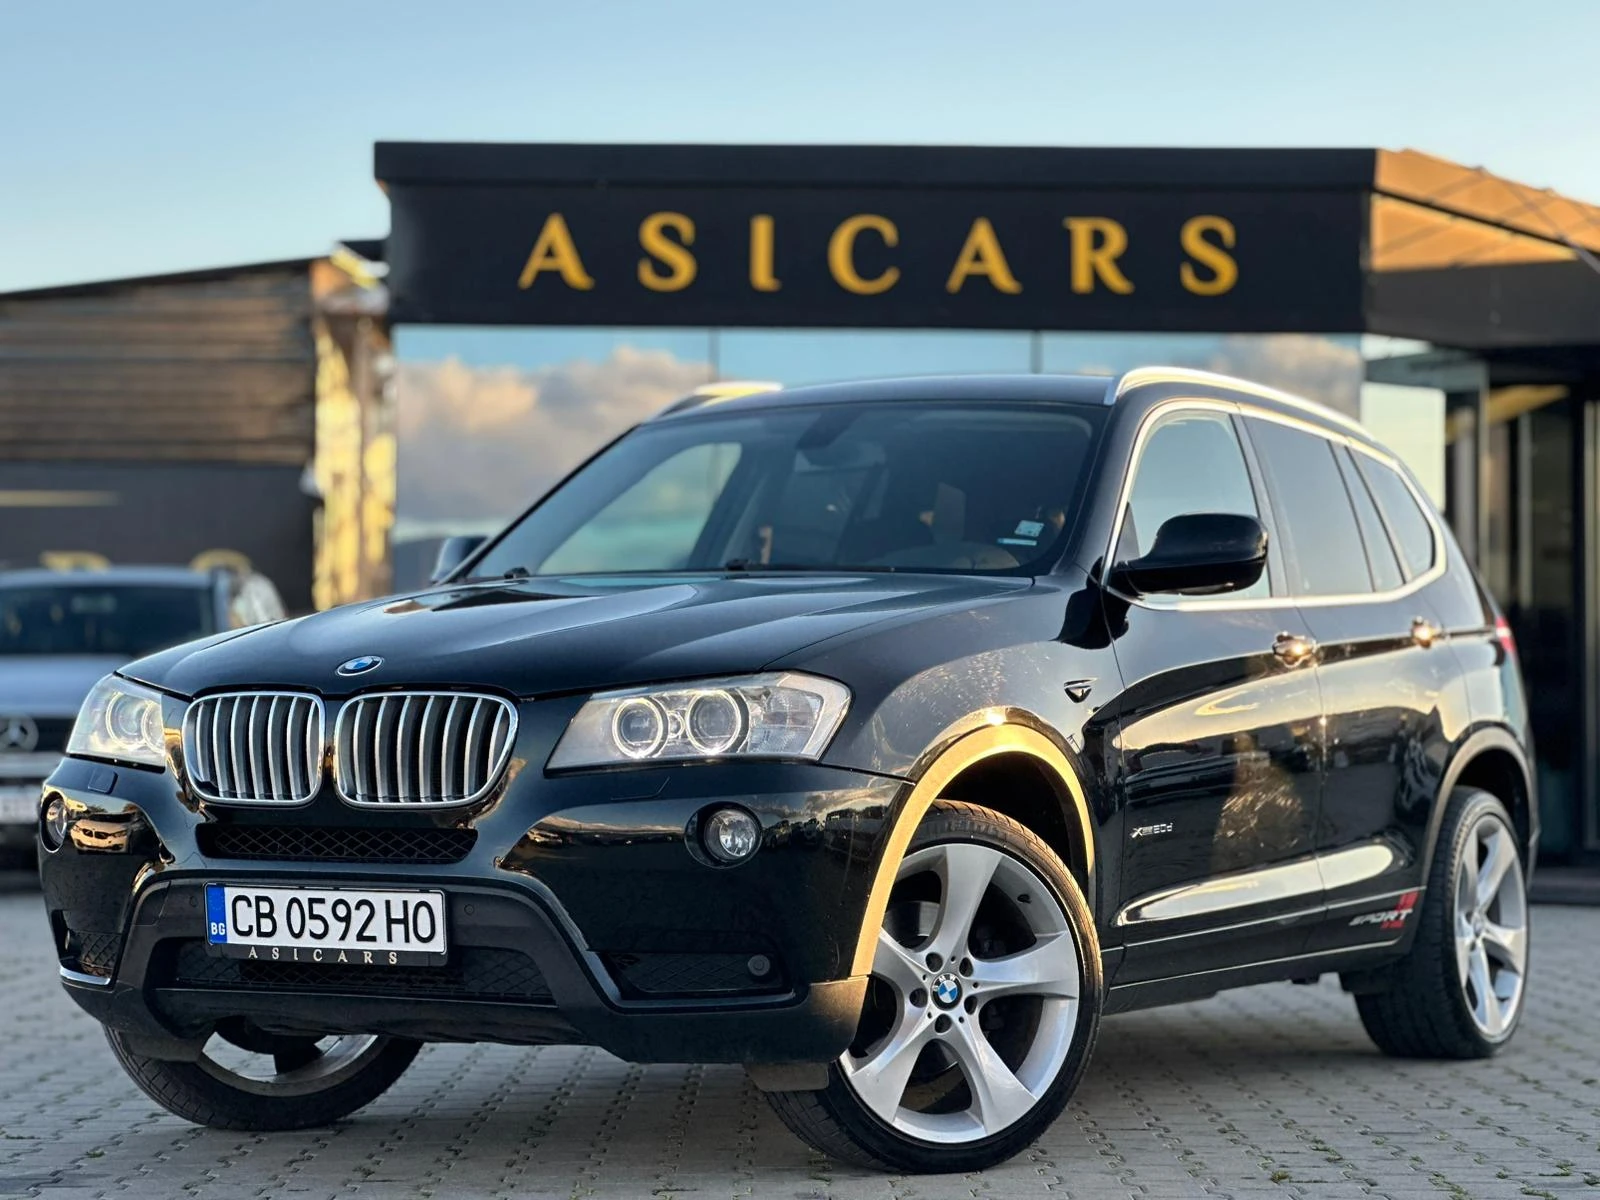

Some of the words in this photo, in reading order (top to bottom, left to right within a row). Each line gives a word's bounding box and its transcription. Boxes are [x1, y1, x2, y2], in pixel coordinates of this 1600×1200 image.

[518, 212, 1239, 295] ASICARS
[231, 894, 278, 938] CB
[286, 896, 377, 942] 0592
[385, 899, 436, 944] HO
[1348, 908, 1413, 926] SPORT
[211, 923, 225, 936] BG
[248, 946, 398, 965] ASICARS
